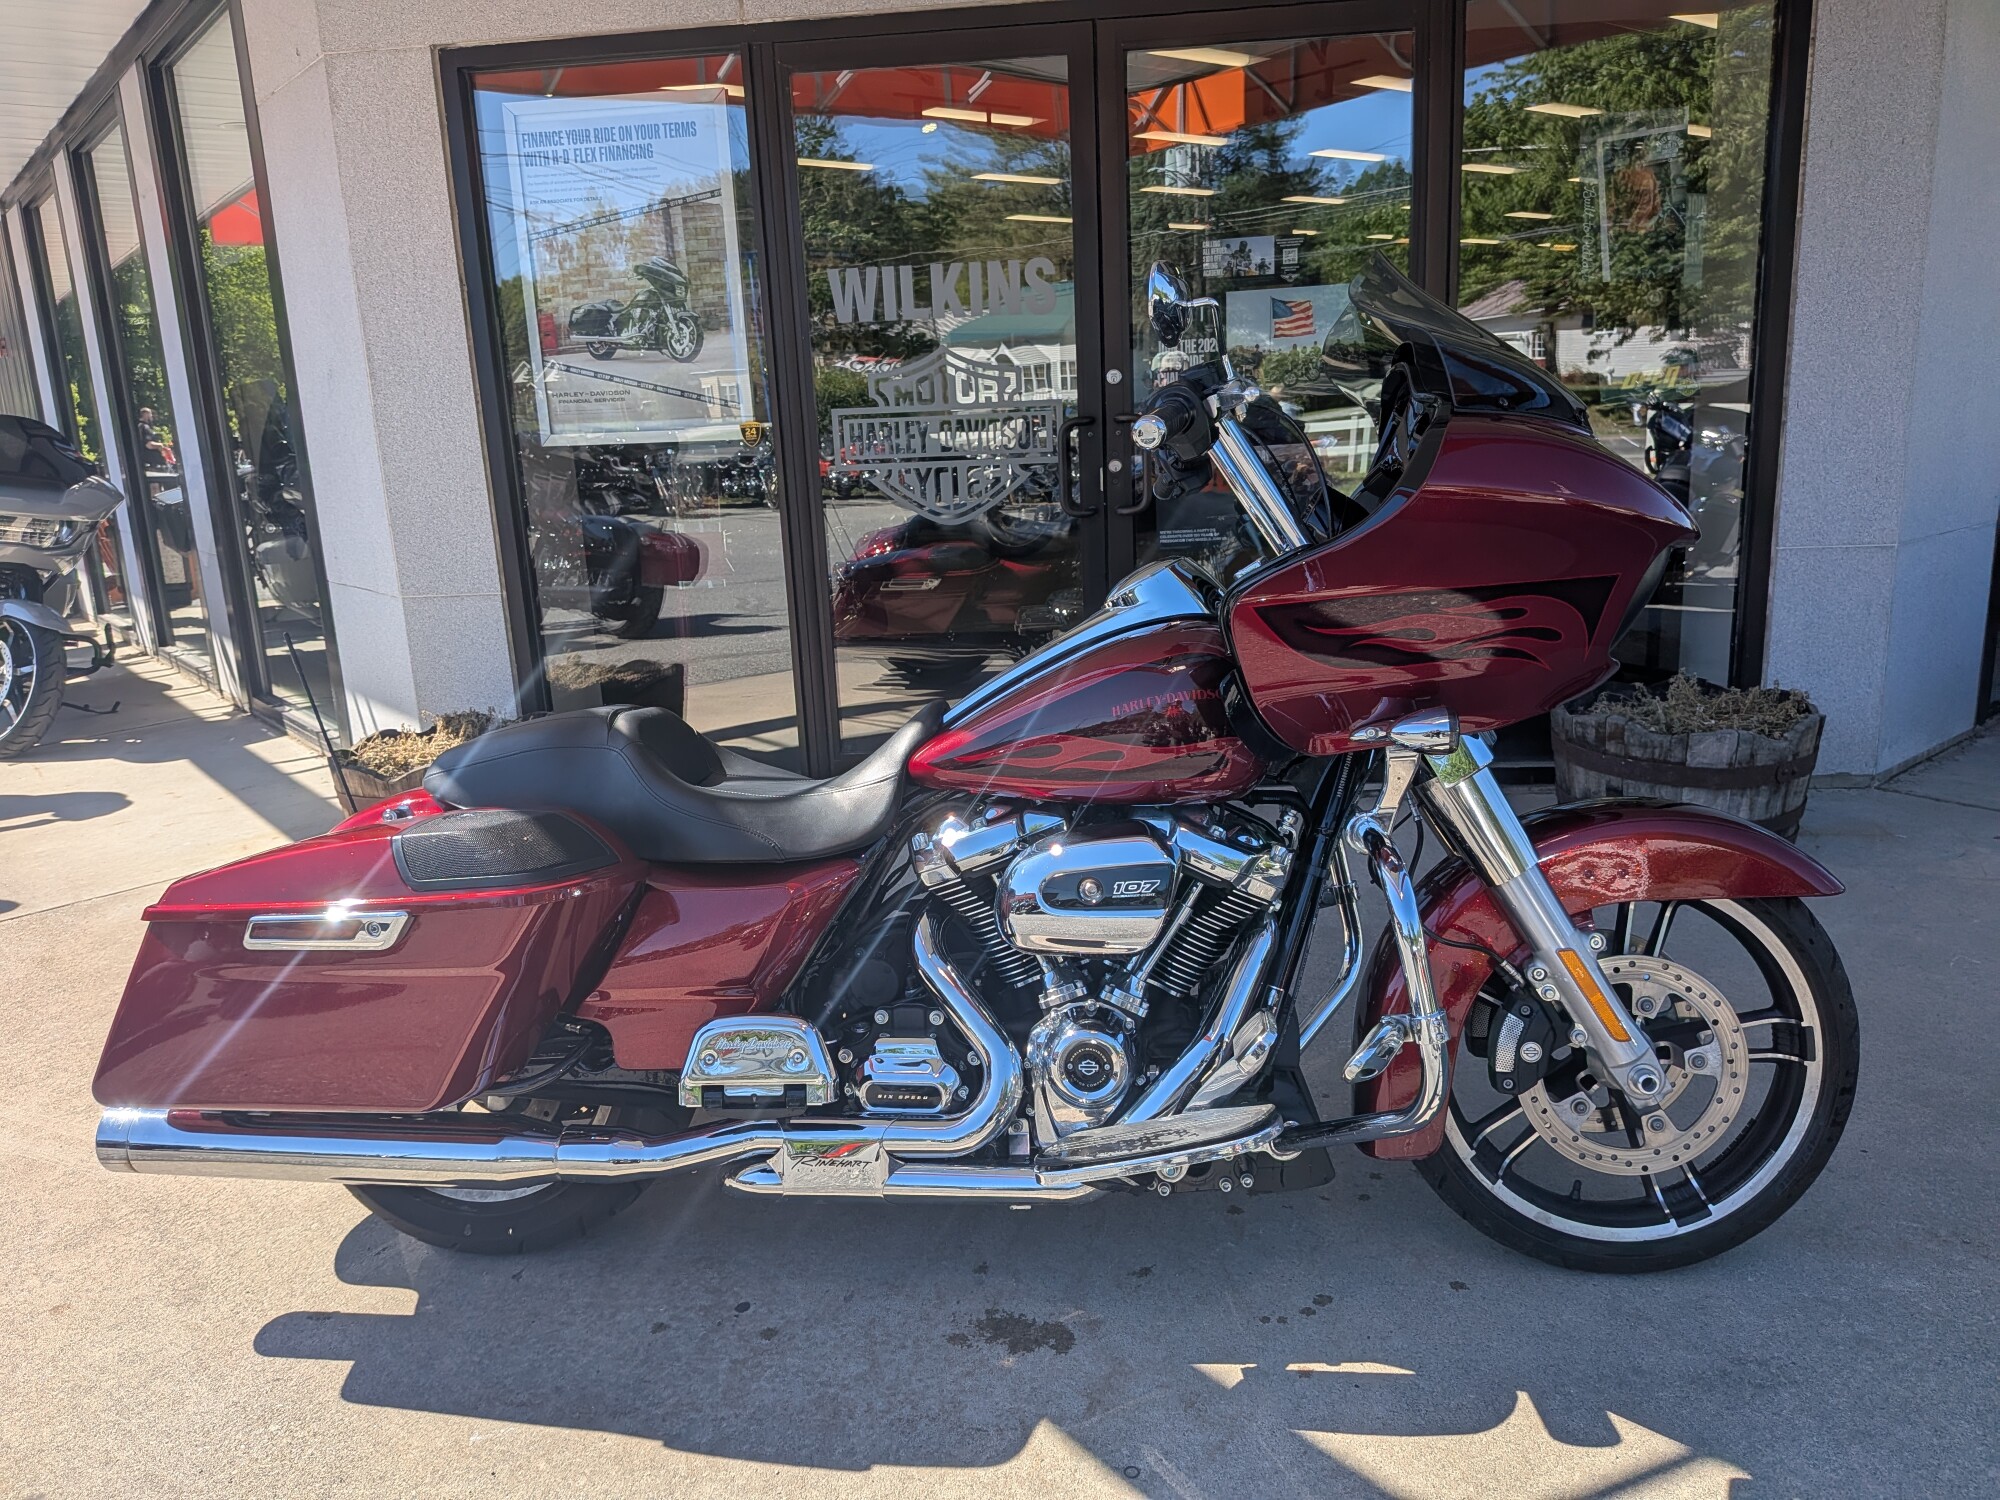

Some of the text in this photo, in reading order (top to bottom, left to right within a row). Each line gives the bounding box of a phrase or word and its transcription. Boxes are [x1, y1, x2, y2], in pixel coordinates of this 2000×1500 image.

[522, 120, 697, 148] FINANCE YOUR RIDE ON YOUR TERMS
[523, 150, 549, 167] WITH
[574, 148, 598, 164] FLEX
[600, 143, 654, 162] FINANCING
[826, 257, 1057, 324] WILKINS
[1180, 339, 1196, 354] THE
[1198, 337, 1219, 353] 202
[894, 364, 999, 407] MOTOR
[745, 427, 757, 436] 24
[849, 414, 1048, 456] HARLEY-DAVIDSON
[899, 464, 1001, 511] CYCLES
[1111, 689, 1221, 717] HARLEY-DAVIDSO
[1112, 879, 1161, 895] 107
[790, 1155, 873, 1170] RINEHART
